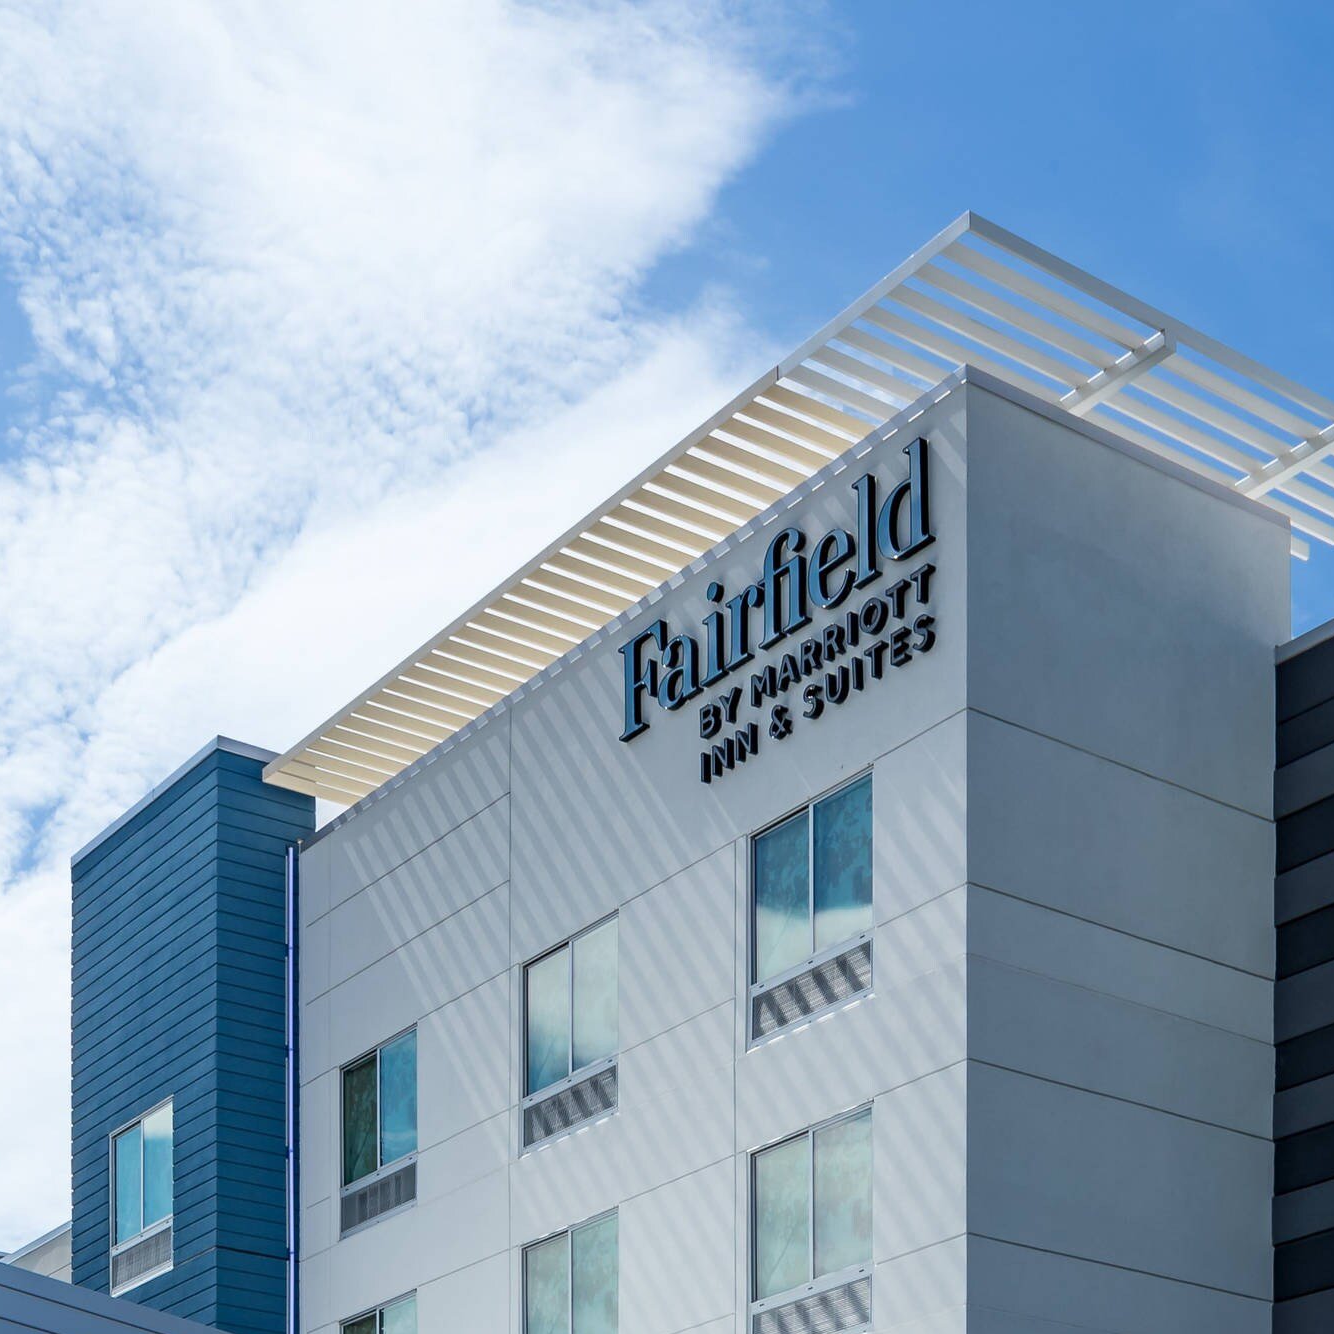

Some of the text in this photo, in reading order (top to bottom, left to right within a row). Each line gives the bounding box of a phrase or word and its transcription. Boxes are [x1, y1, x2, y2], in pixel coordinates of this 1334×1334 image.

[618, 436, 936, 743] Fairfield
[700, 563, 936, 739] BY MARRIOTT
[700, 613, 935, 784] INN & SUITES
